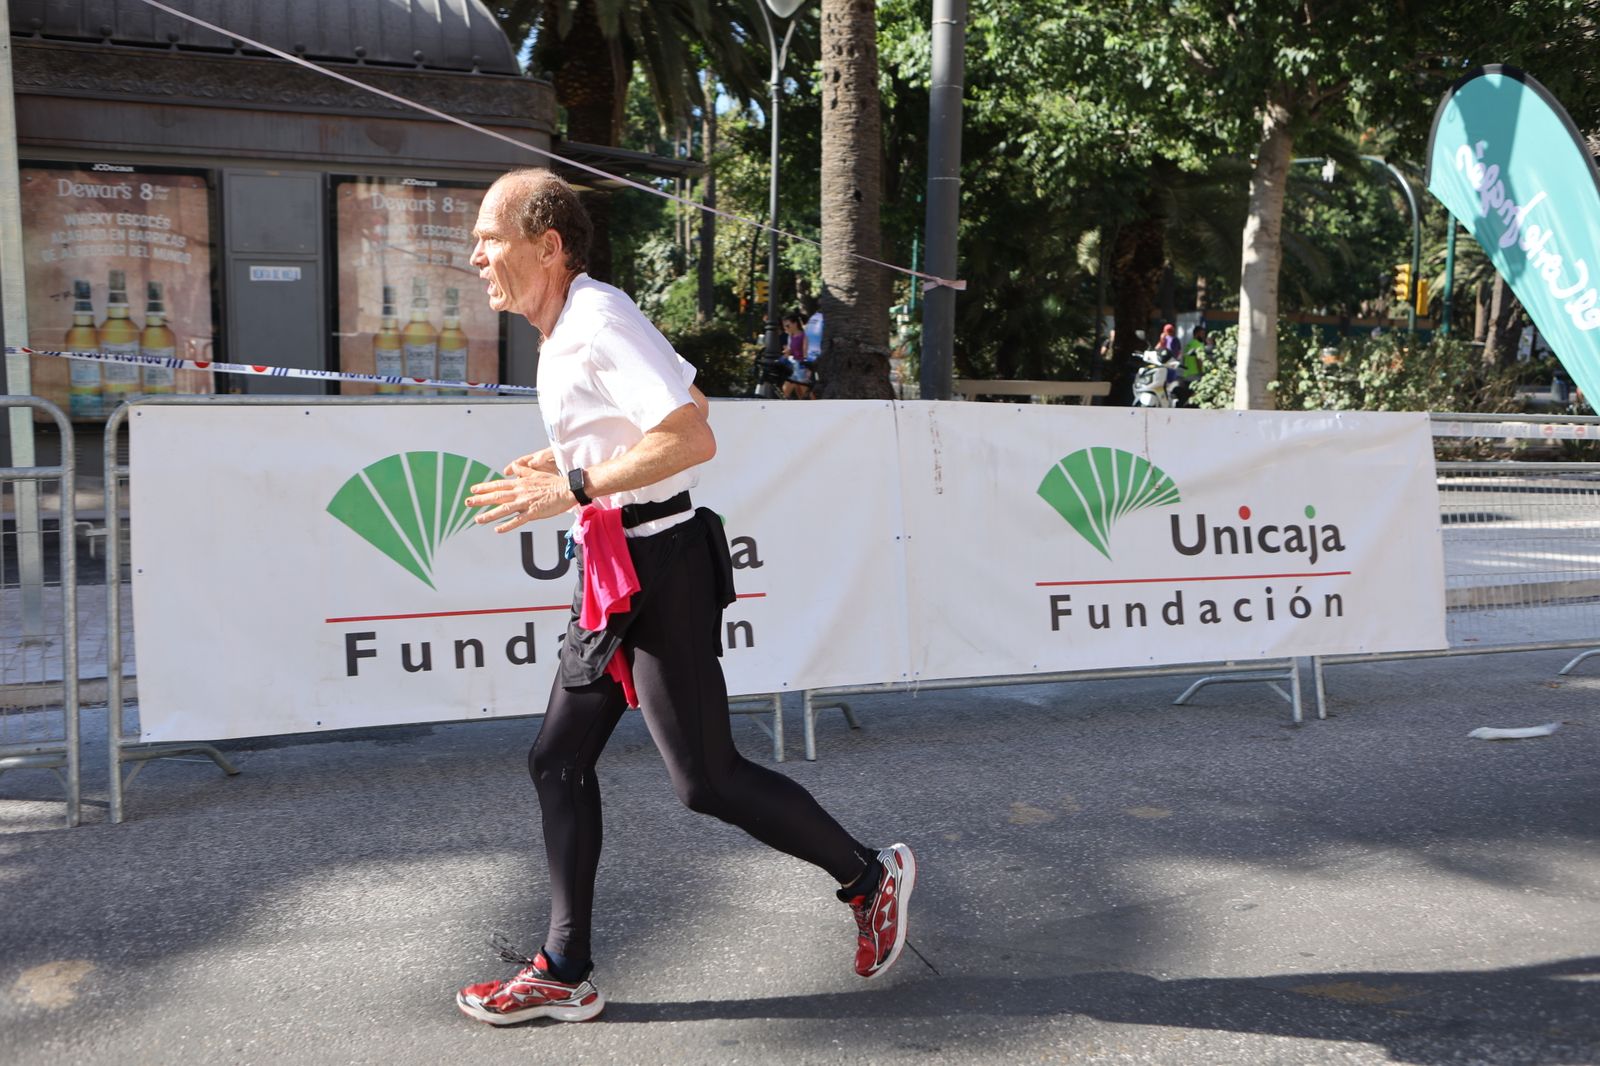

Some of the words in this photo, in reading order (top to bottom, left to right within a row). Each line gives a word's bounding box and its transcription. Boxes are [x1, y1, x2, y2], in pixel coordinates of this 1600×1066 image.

[56, 178, 133, 200] Dewar's
[139, 183, 154, 201] 8
[442, 196, 454, 213] 8
[1170, 505, 1346, 565] Unicaja
[1050, 586, 1344, 631] Fundación
